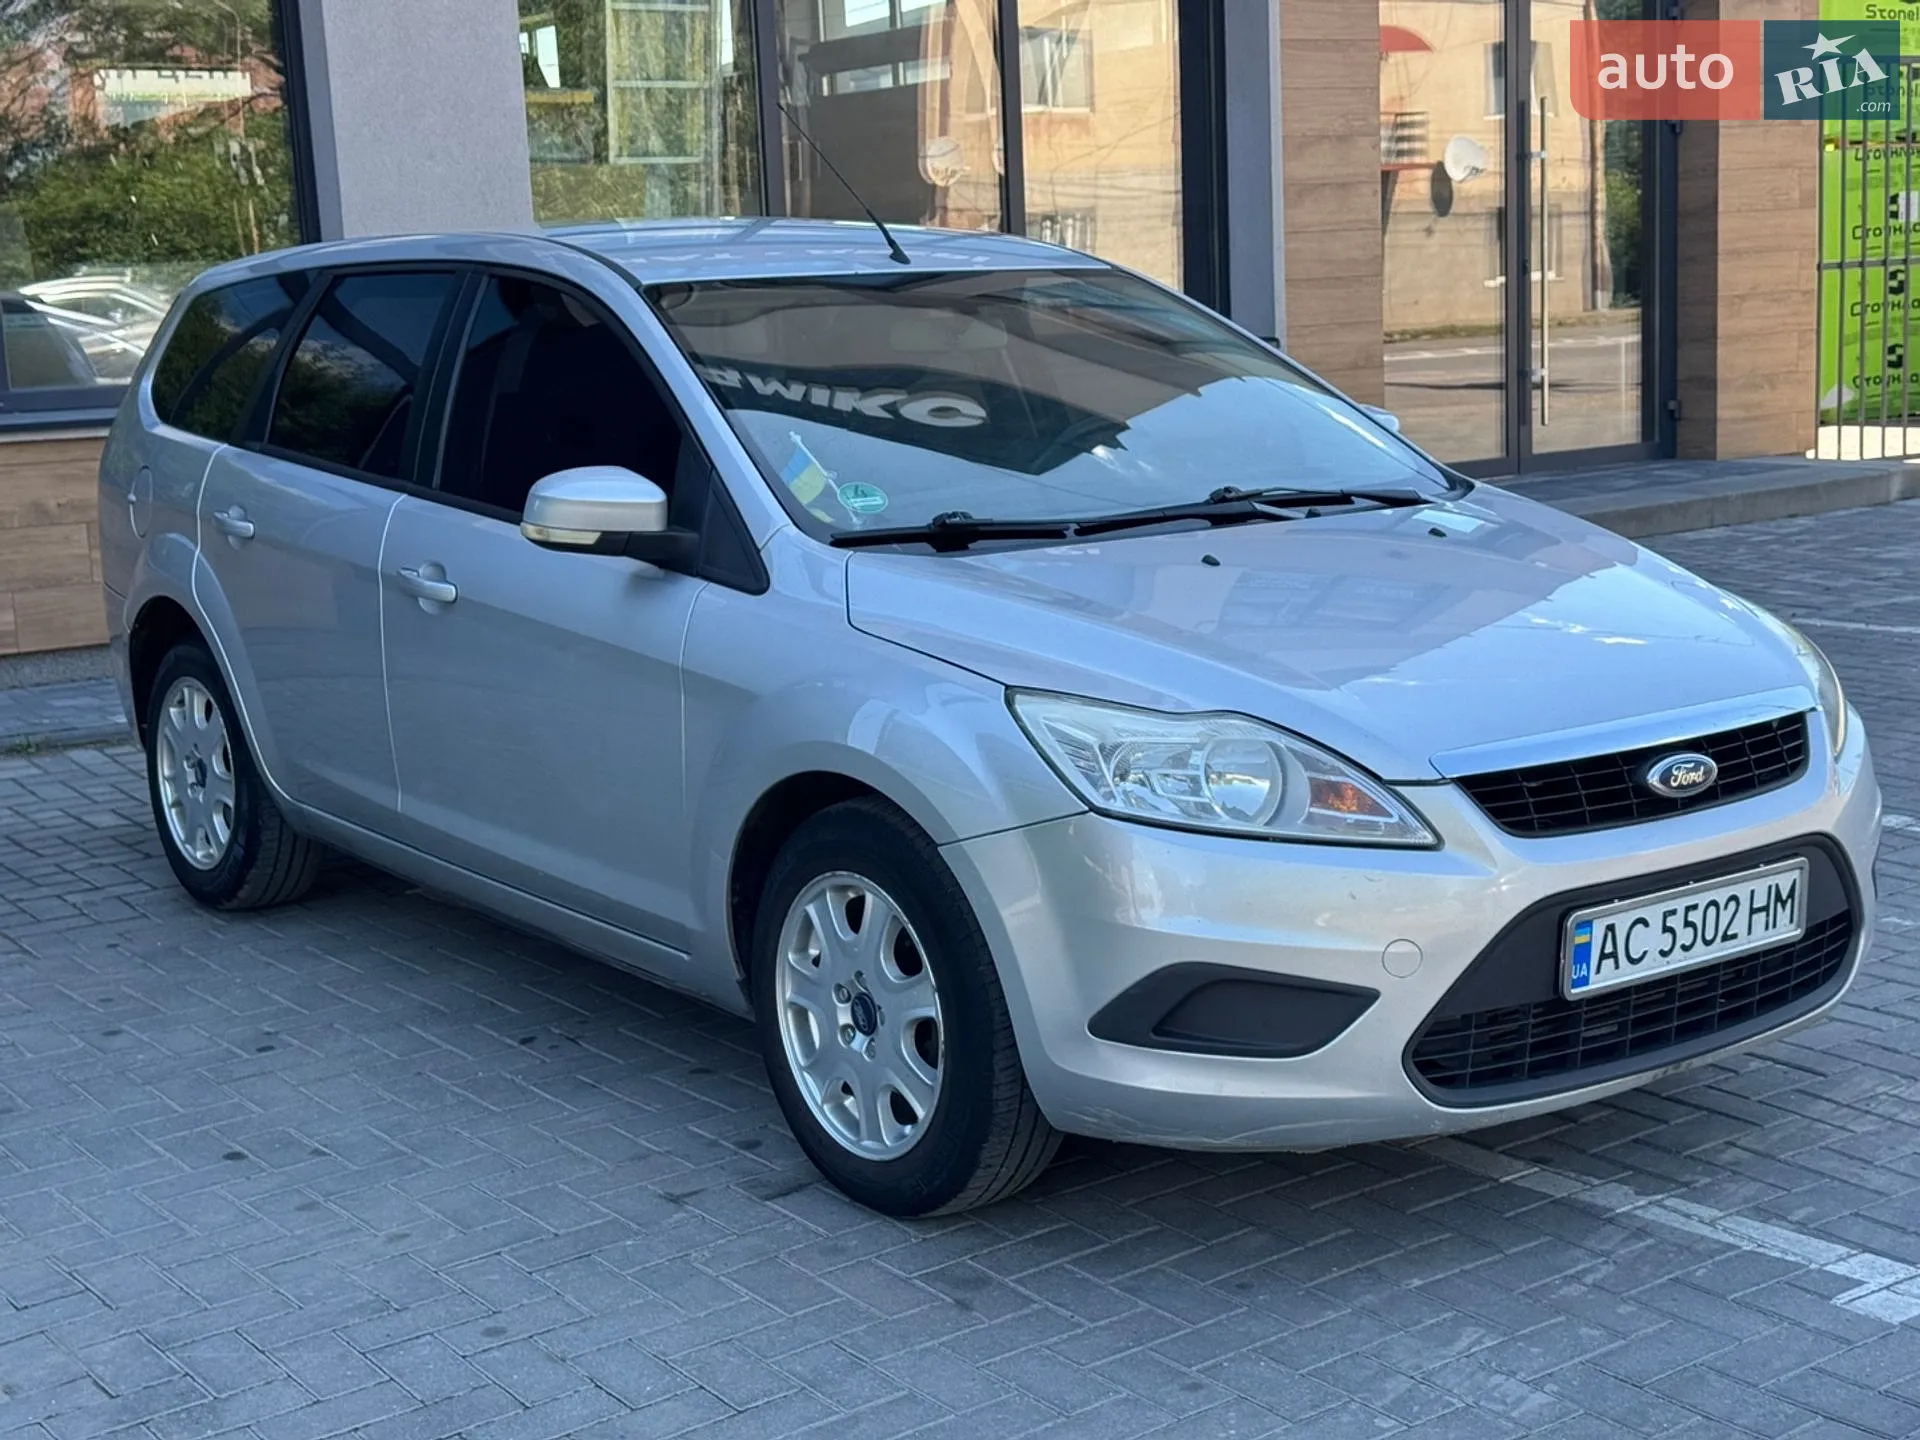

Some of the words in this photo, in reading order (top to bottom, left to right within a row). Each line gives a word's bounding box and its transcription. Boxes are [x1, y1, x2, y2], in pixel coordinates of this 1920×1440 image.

[1670, 762, 1704, 787] Ford
[1595, 916, 1651, 975] AC
[1658, 893, 1741, 958] 5502
[1747, 878, 1797, 936] HM
[1572, 963, 1588, 979] UA
